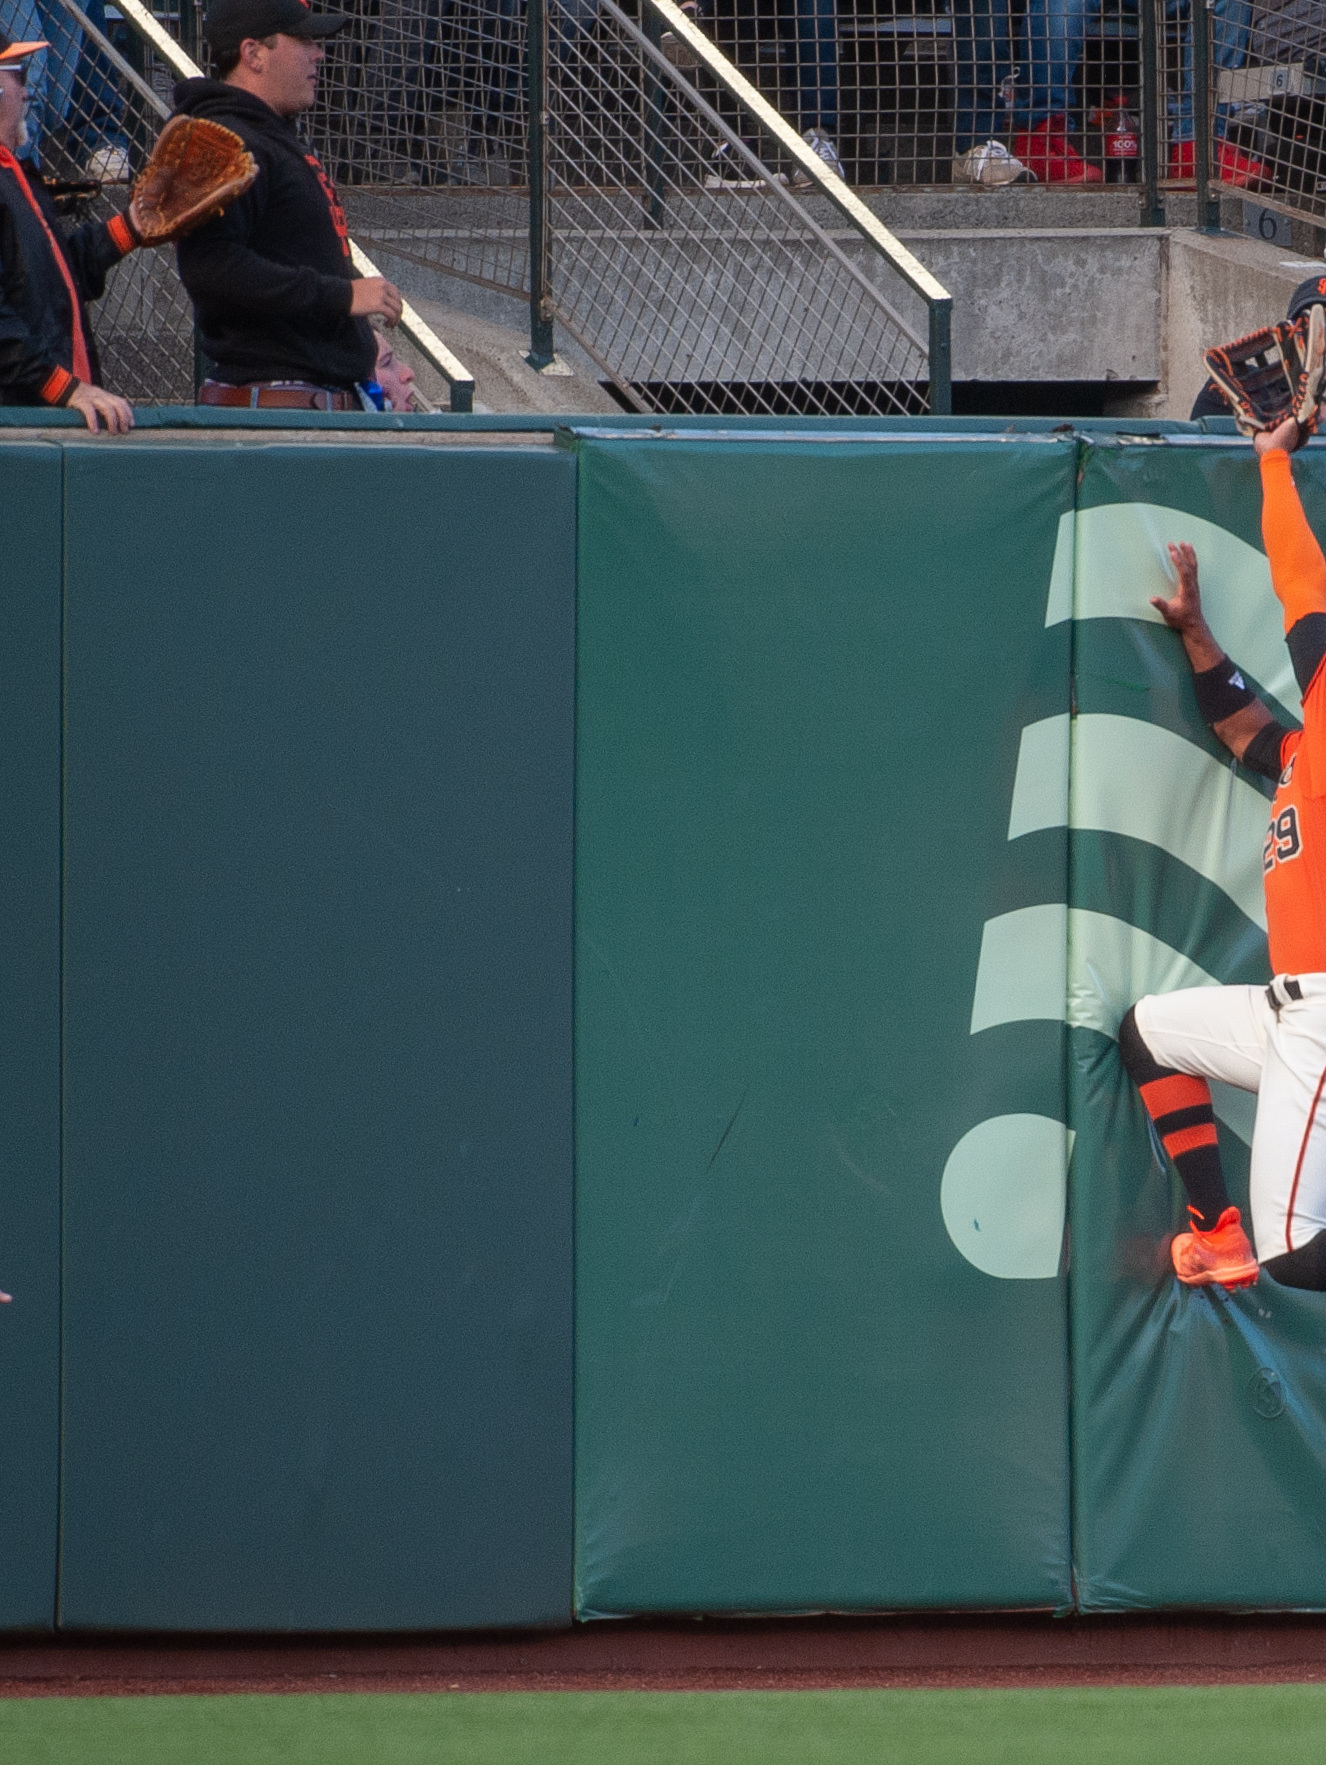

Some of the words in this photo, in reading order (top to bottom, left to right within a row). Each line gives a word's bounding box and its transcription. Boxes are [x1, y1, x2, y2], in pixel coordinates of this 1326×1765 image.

[1275, 74, 1284, 88] 6
[1259, 207, 1278, 241] 6
[1262, 804, 1304, 875] 29
